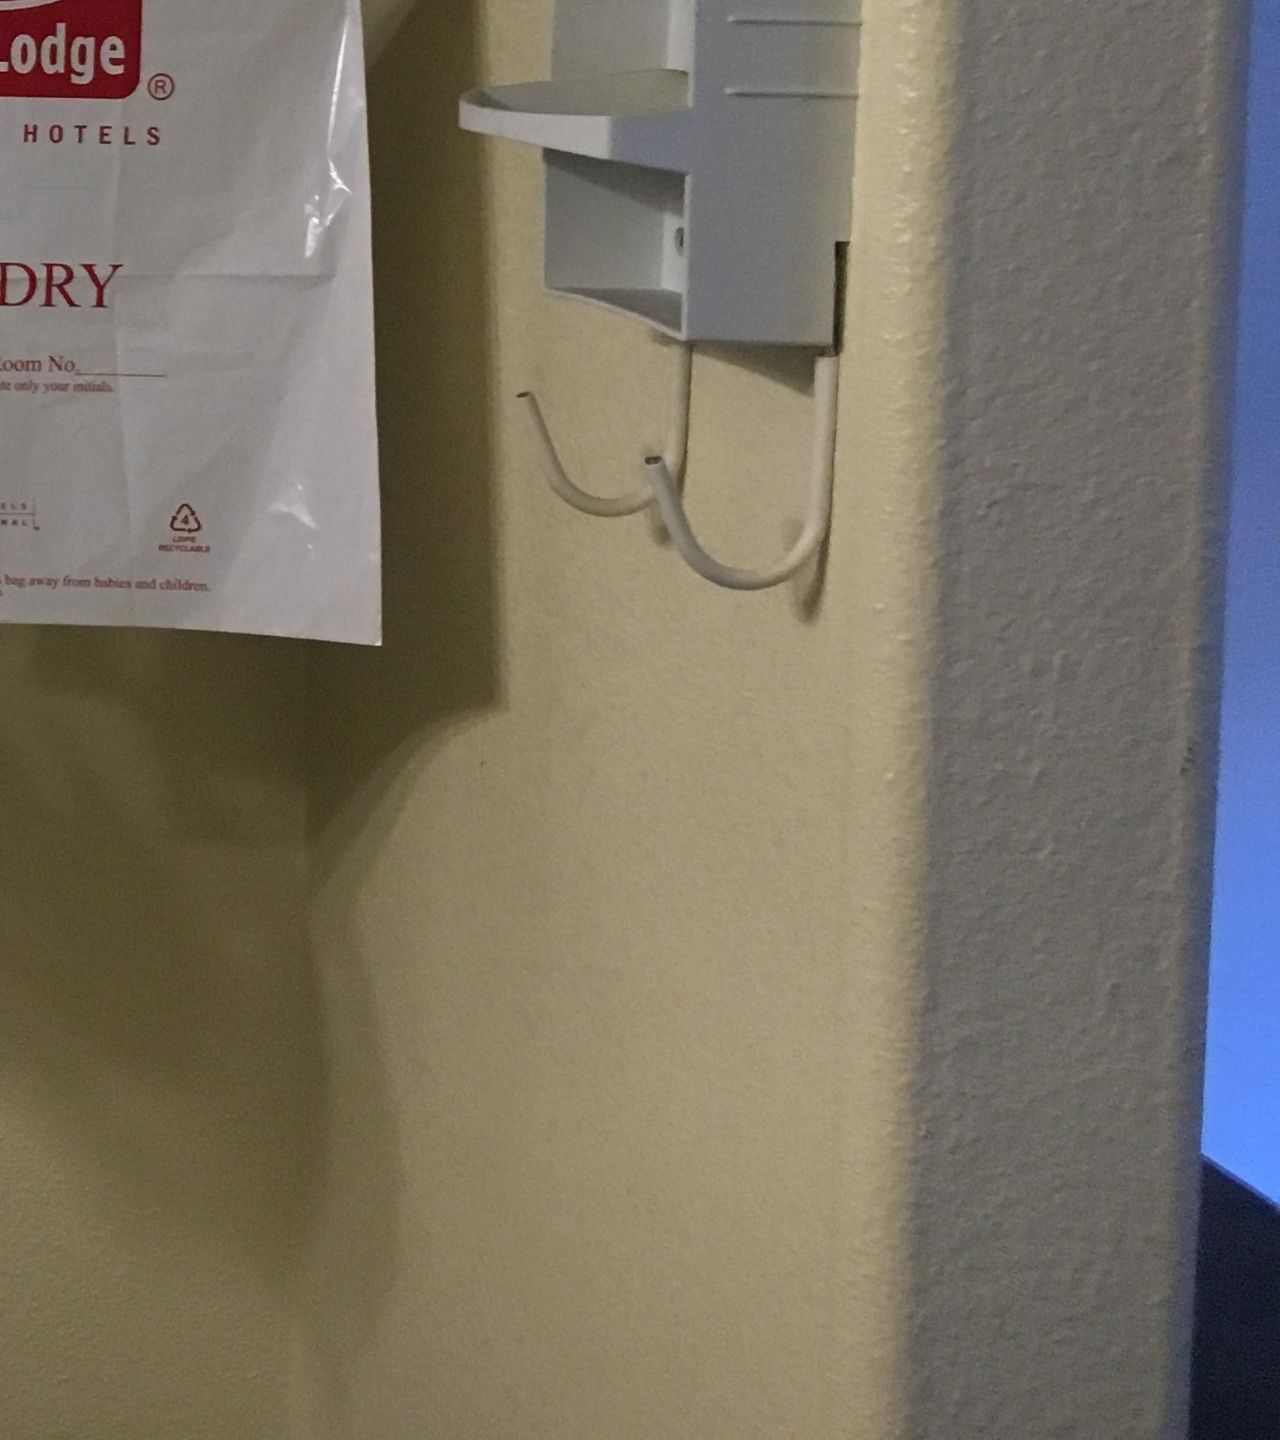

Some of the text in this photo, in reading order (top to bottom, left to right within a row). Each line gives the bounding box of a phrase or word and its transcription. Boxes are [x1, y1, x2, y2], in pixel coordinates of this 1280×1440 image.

[23, 123, 161, 146] HOTELS
[14, 379, 40, 394] only
[43, 381, 71, 394] your
[180, 514, 190, 526] 4
[4, 573, 27, 589] bag
[28, 576, 59, 589] away
[63, 575, 91, 588] from
[94, 575, 133, 589] babies
[134, 578, 157, 590] and
